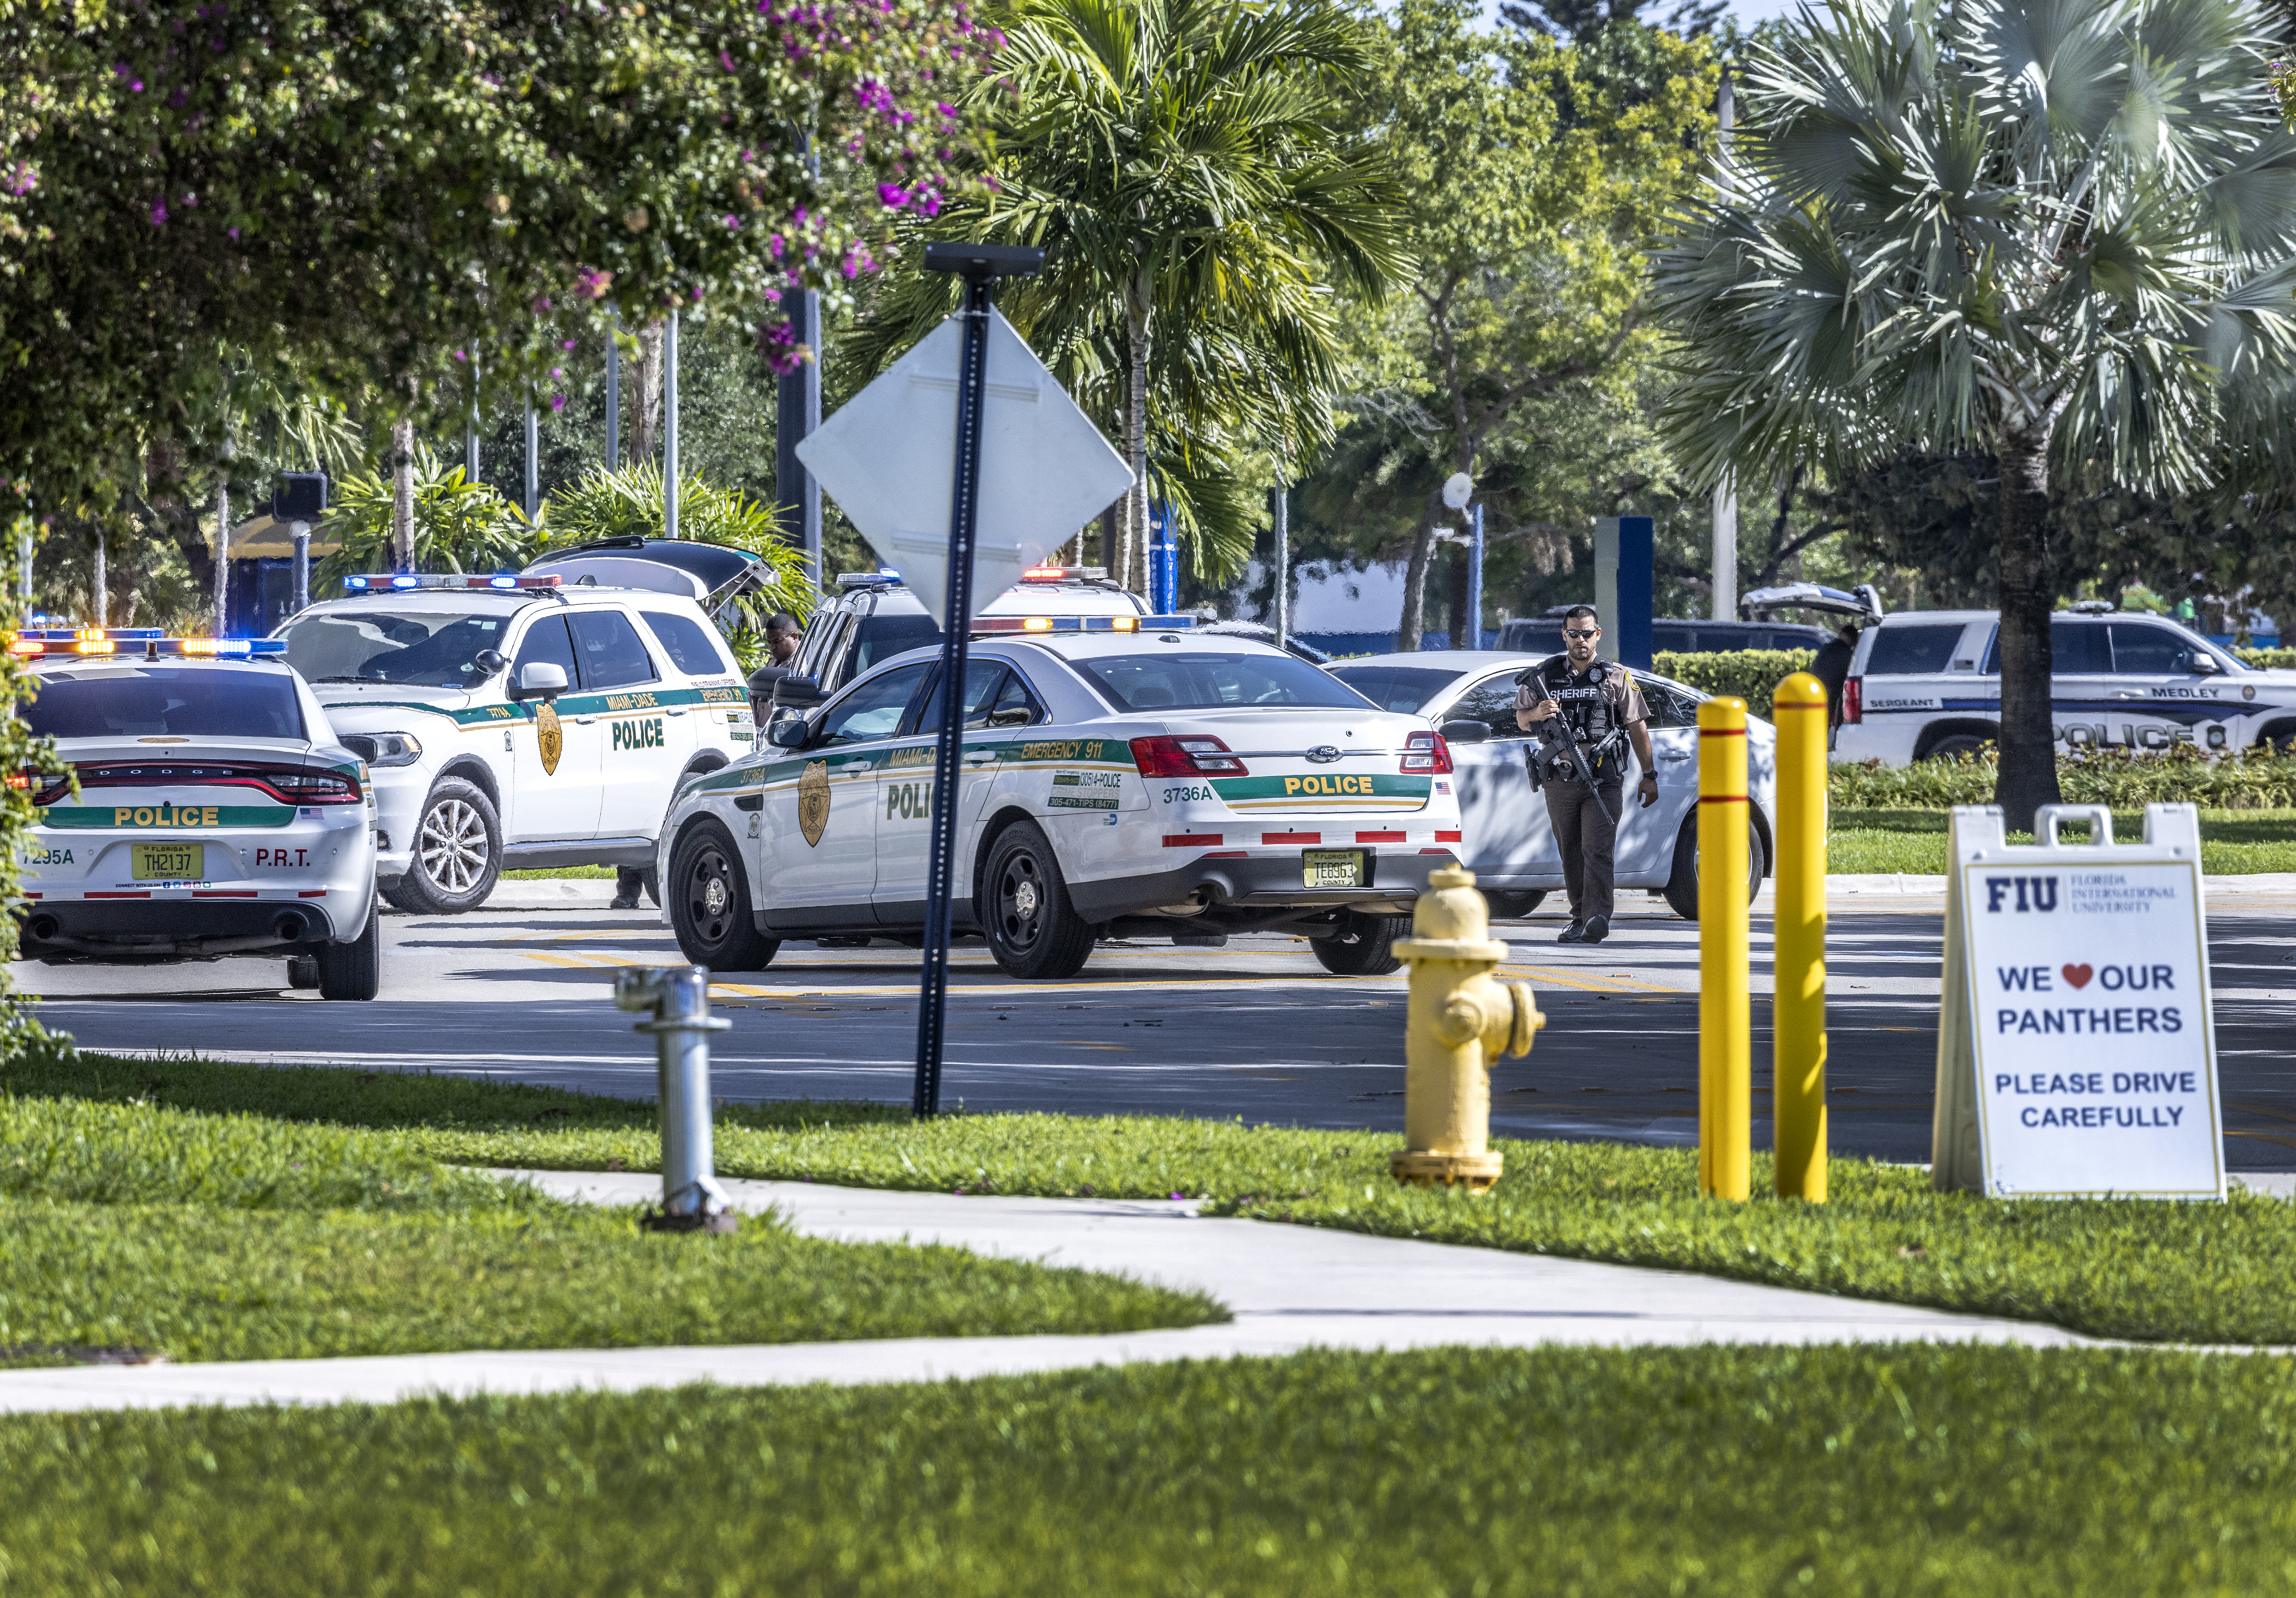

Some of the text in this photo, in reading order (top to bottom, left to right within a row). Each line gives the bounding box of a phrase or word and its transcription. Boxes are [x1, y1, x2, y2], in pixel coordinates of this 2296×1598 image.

[606, 693, 658, 710] MIAMI-DADE
[699, 689, 733, 701] EMERGENCY
[1550, 689, 1597, 700] SHERIFF
[2152, 688, 2219, 698] MEDLEY
[1870, 698, 1934, 707] SERGEANT
[612, 718, 664, 751] POLICE
[889, 746, 937, 766] MIAMI-D
[1021, 741, 1103, 759] EMERGENCY 911
[740, 768, 765, 784] 3736A
[1051, 786, 1120, 799] CRIME STOPPERS
[1284, 776, 1374, 795] POLICE
[887, 783, 934, 820] POLI
[1050, 798, 1117, 808] 305-471-TIPS (8477)
[1164, 786, 1213, 803] 3736A
[115, 807, 218, 826] POLICE
[145, 854, 191, 870] TH2137
[256, 848, 310, 867] P.R.T.
[1314, 862, 1353, 878] TE8963
[2071, 875, 2126, 886] FLORIDA
[1986, 876, 2057, 913] FIU
[2071, 886, 2175, 898] INTERNATIONAL
[2072, 902, 2150, 913] UNIVERSITY
[1997, 964, 2175, 992] WE OUR
[1998, 1007, 2183, 1033] PANTHERS
[1995, 1071, 2196, 1094] PLEASE DRIVE
[2020, 1105, 2183, 1127] CAREFULLY
